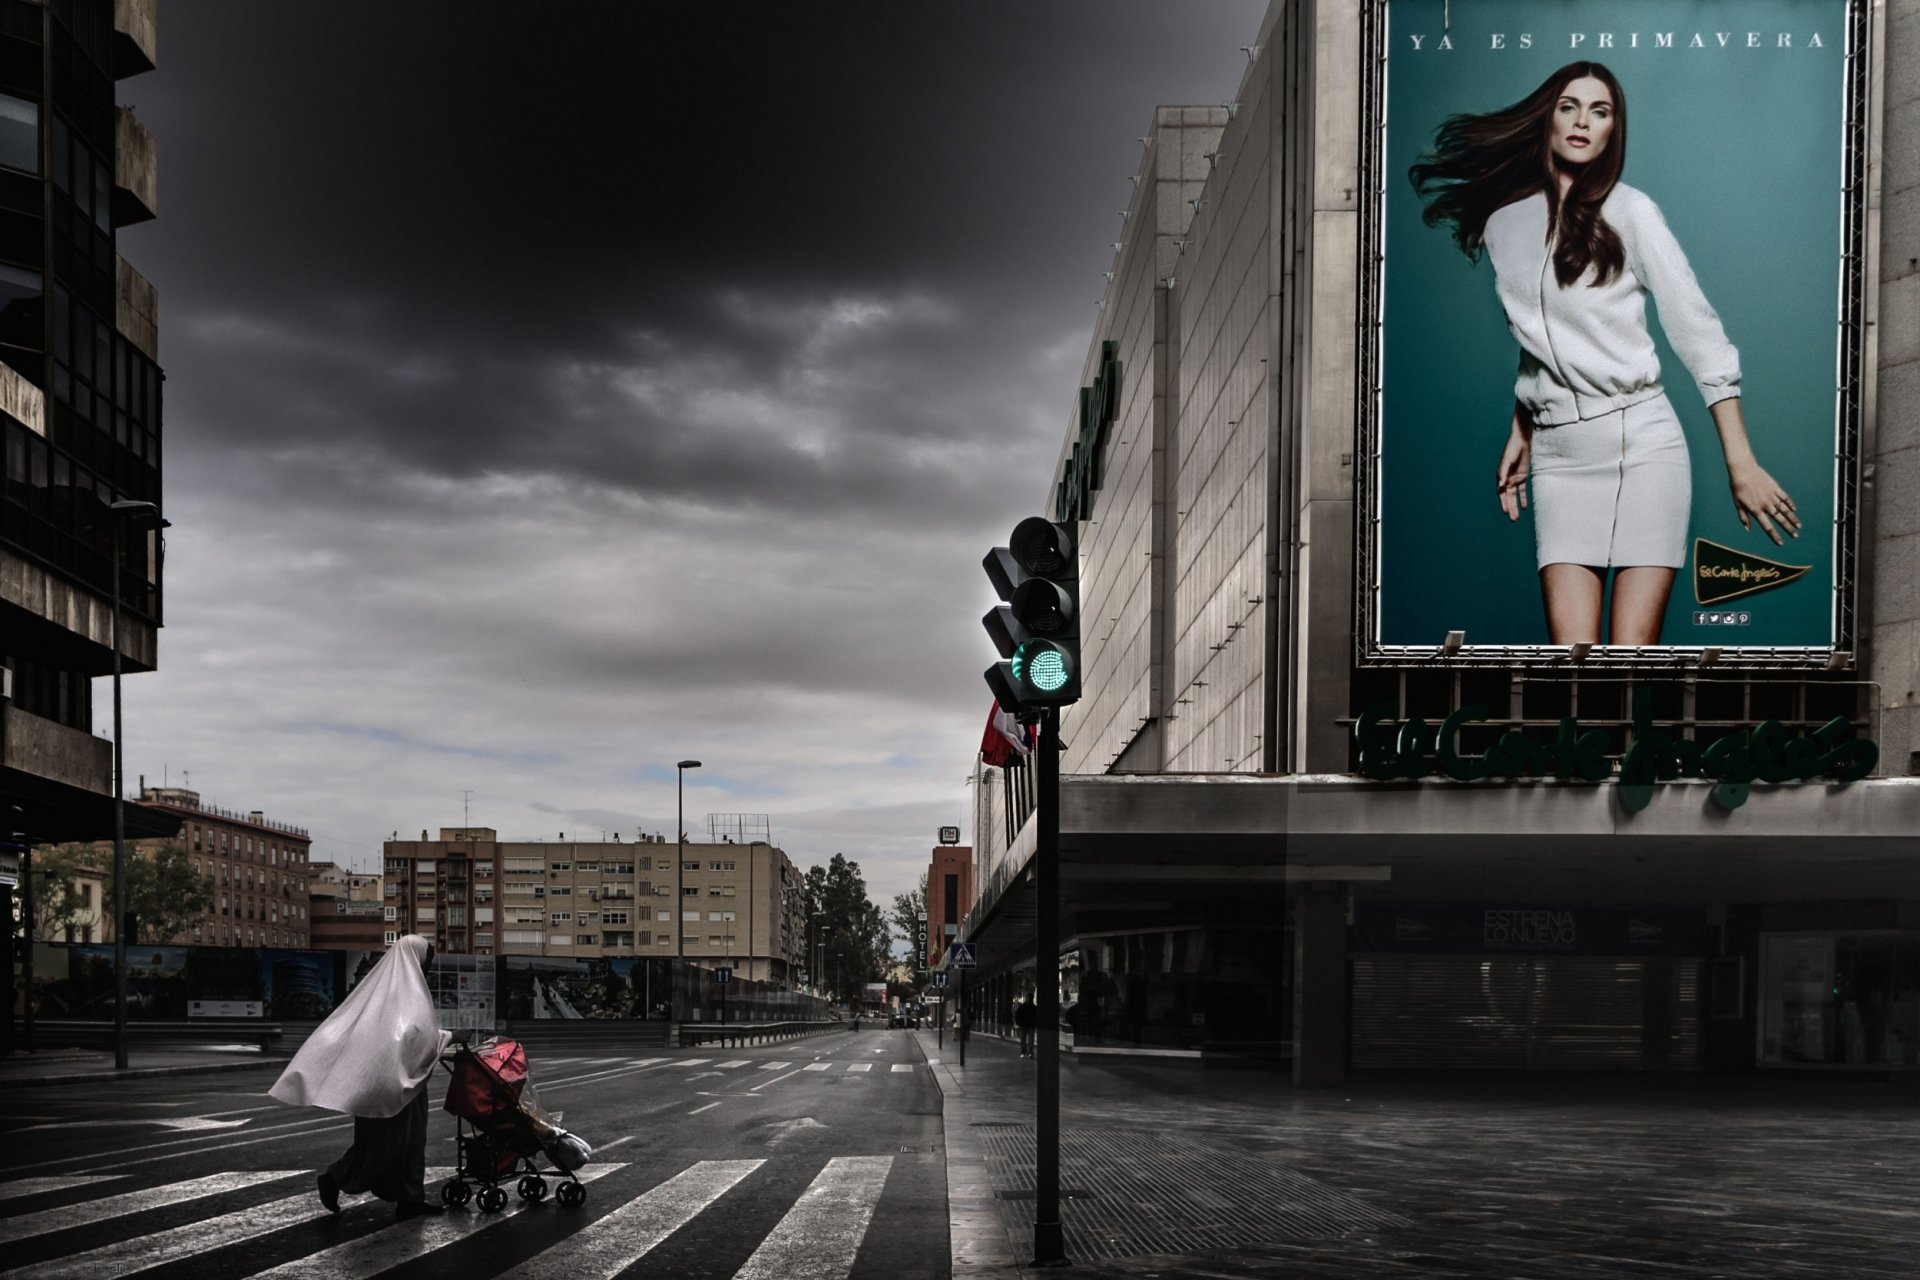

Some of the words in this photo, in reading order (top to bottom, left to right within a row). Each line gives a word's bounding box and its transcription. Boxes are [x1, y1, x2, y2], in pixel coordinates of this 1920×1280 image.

[1410, 34, 1454, 50] YA
[1491, 33, 1533, 50] ES
[1570, 31, 1824, 49] PRIMAVERA
[1699, 565, 1711, 578] El
[1712, 566, 1740, 578] Corte
[1355, 699, 1431, 780] El
[1435, 703, 1612, 781] Corte
[1484, 910, 1576, 928] ESTRENA
[1483, 927, 1508, 942] LO
[1511, 927, 1576, 943] NUEVO
[918, 923, 928, 969] HOTEL
